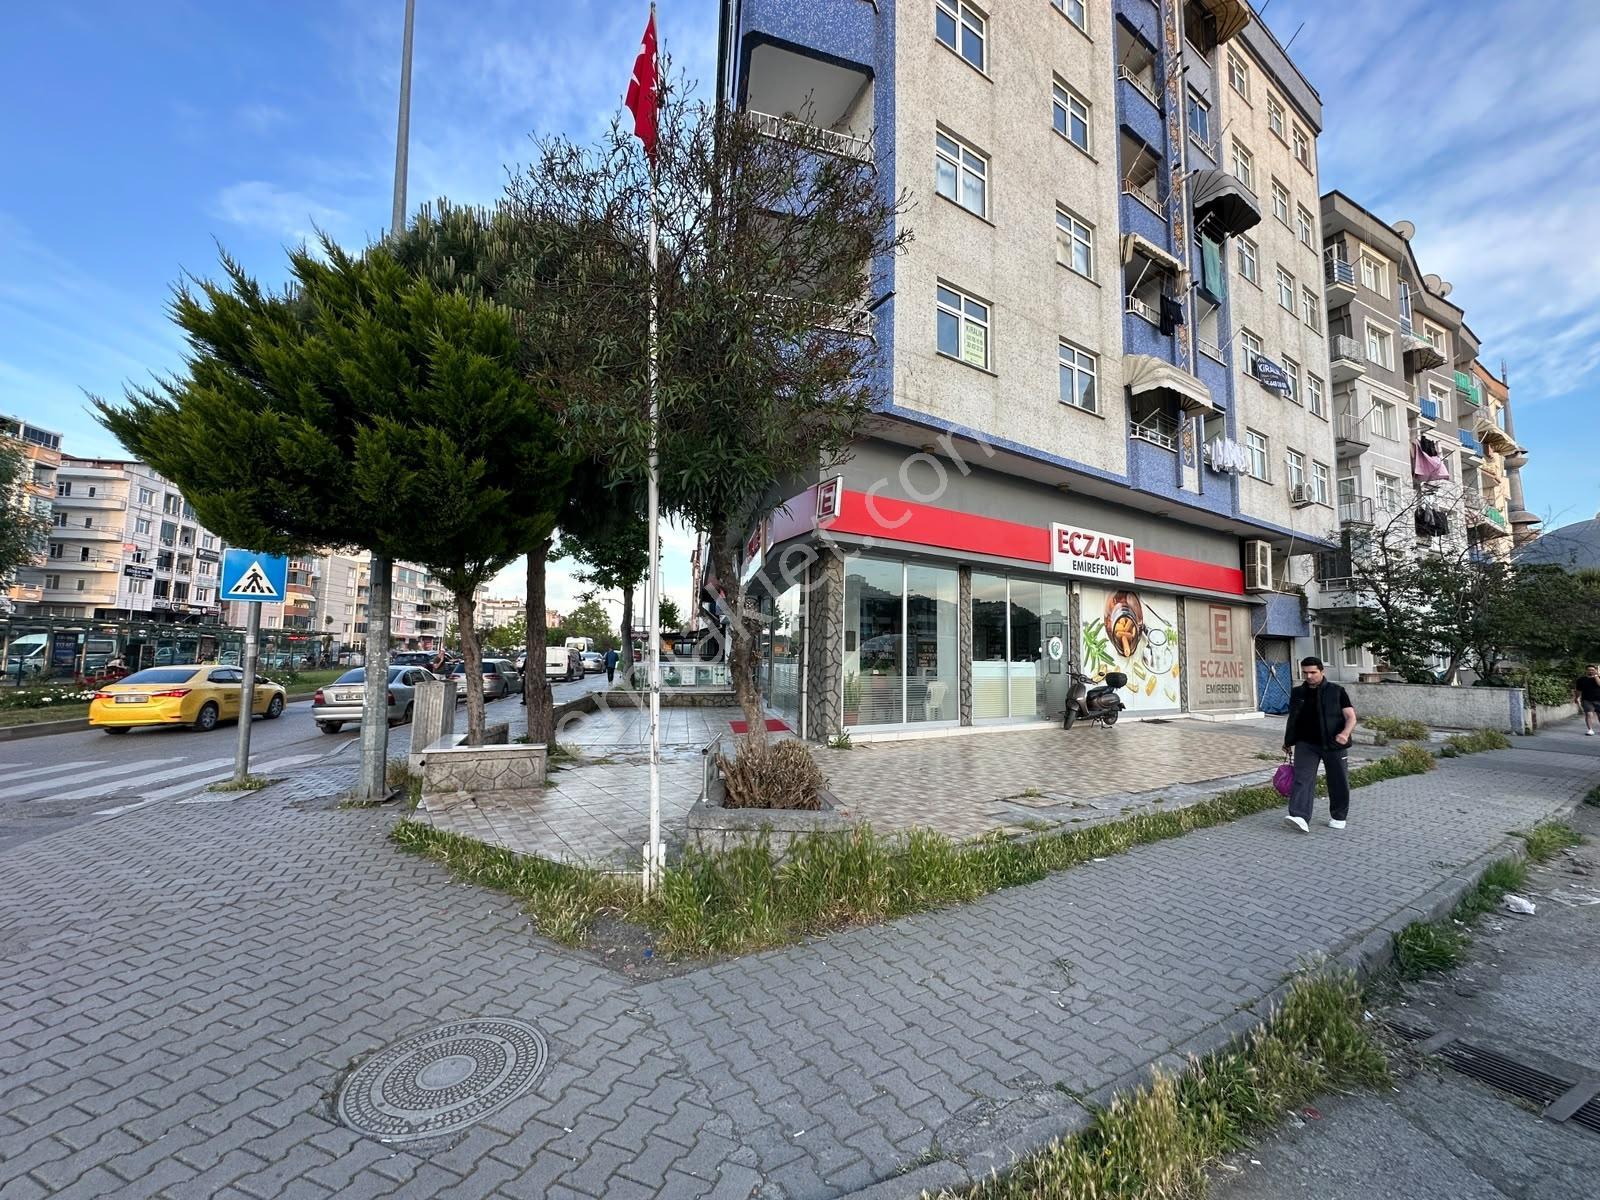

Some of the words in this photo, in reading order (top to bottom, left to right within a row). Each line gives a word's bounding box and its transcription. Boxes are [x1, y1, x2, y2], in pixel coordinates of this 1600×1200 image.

[1057, 528, 1132, 565] ECZANE
[1072, 558, 1119, 577] EMİREFENDİ
[1214, 613, 1228, 646] E
[1200, 660, 1245, 678] ECZANE
